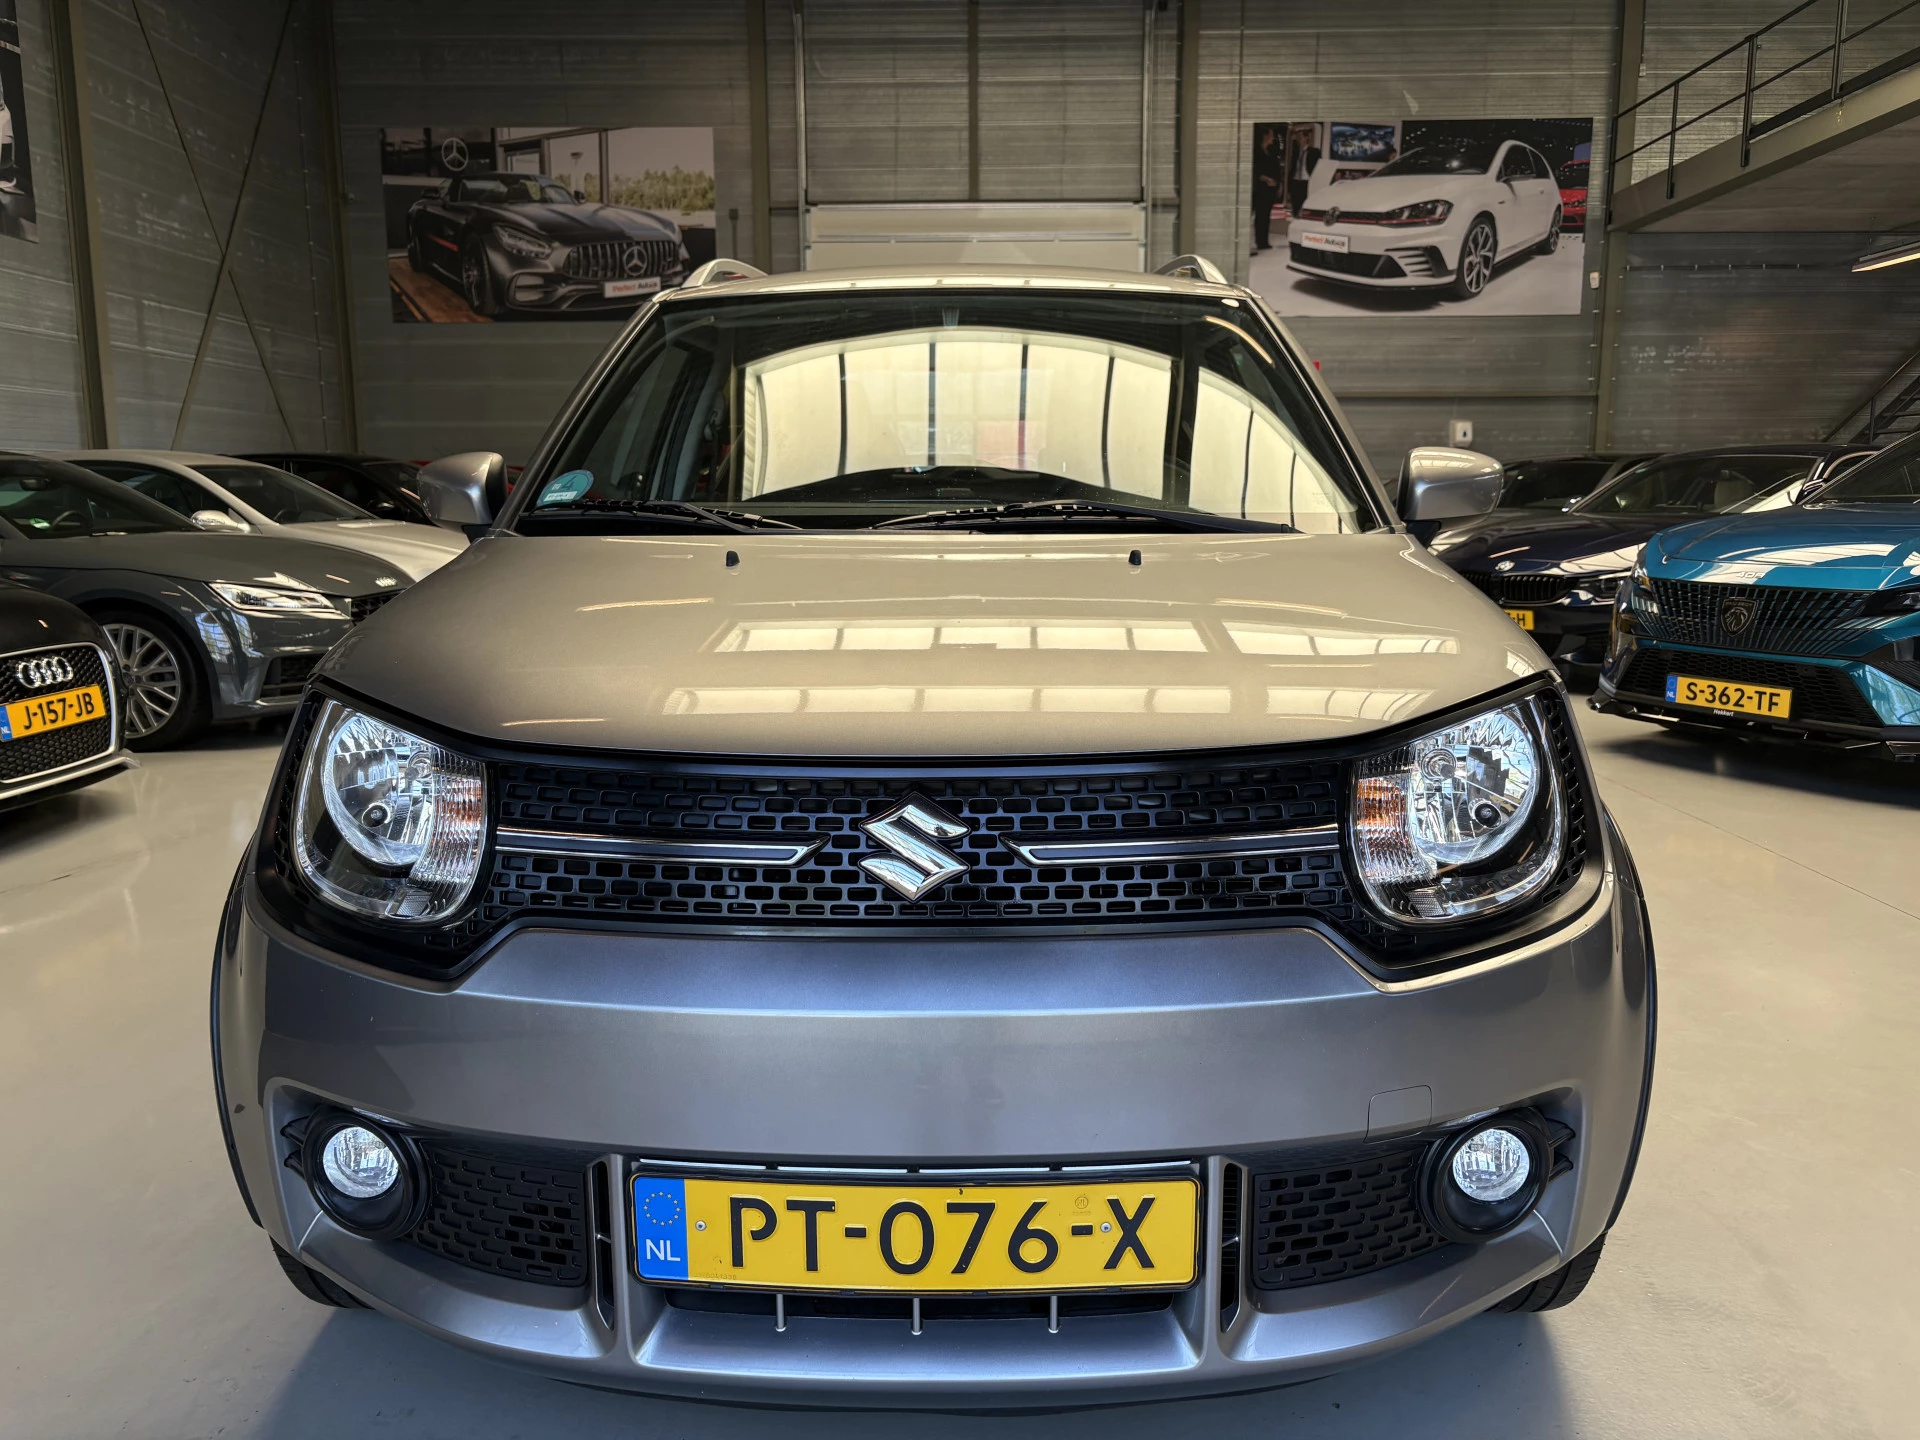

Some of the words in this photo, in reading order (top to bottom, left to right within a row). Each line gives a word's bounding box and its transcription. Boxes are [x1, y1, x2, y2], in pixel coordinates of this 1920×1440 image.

[1666, 691, 1676, 699] NL
[1685, 682, 1780, 712] S-362-TF
[23, 692, 95, 730] J-157-JB
[0, 726, 11, 735] NL
[730, 1195, 1156, 1275] PT-076-X
[645, 1238, 681, 1262] NL
